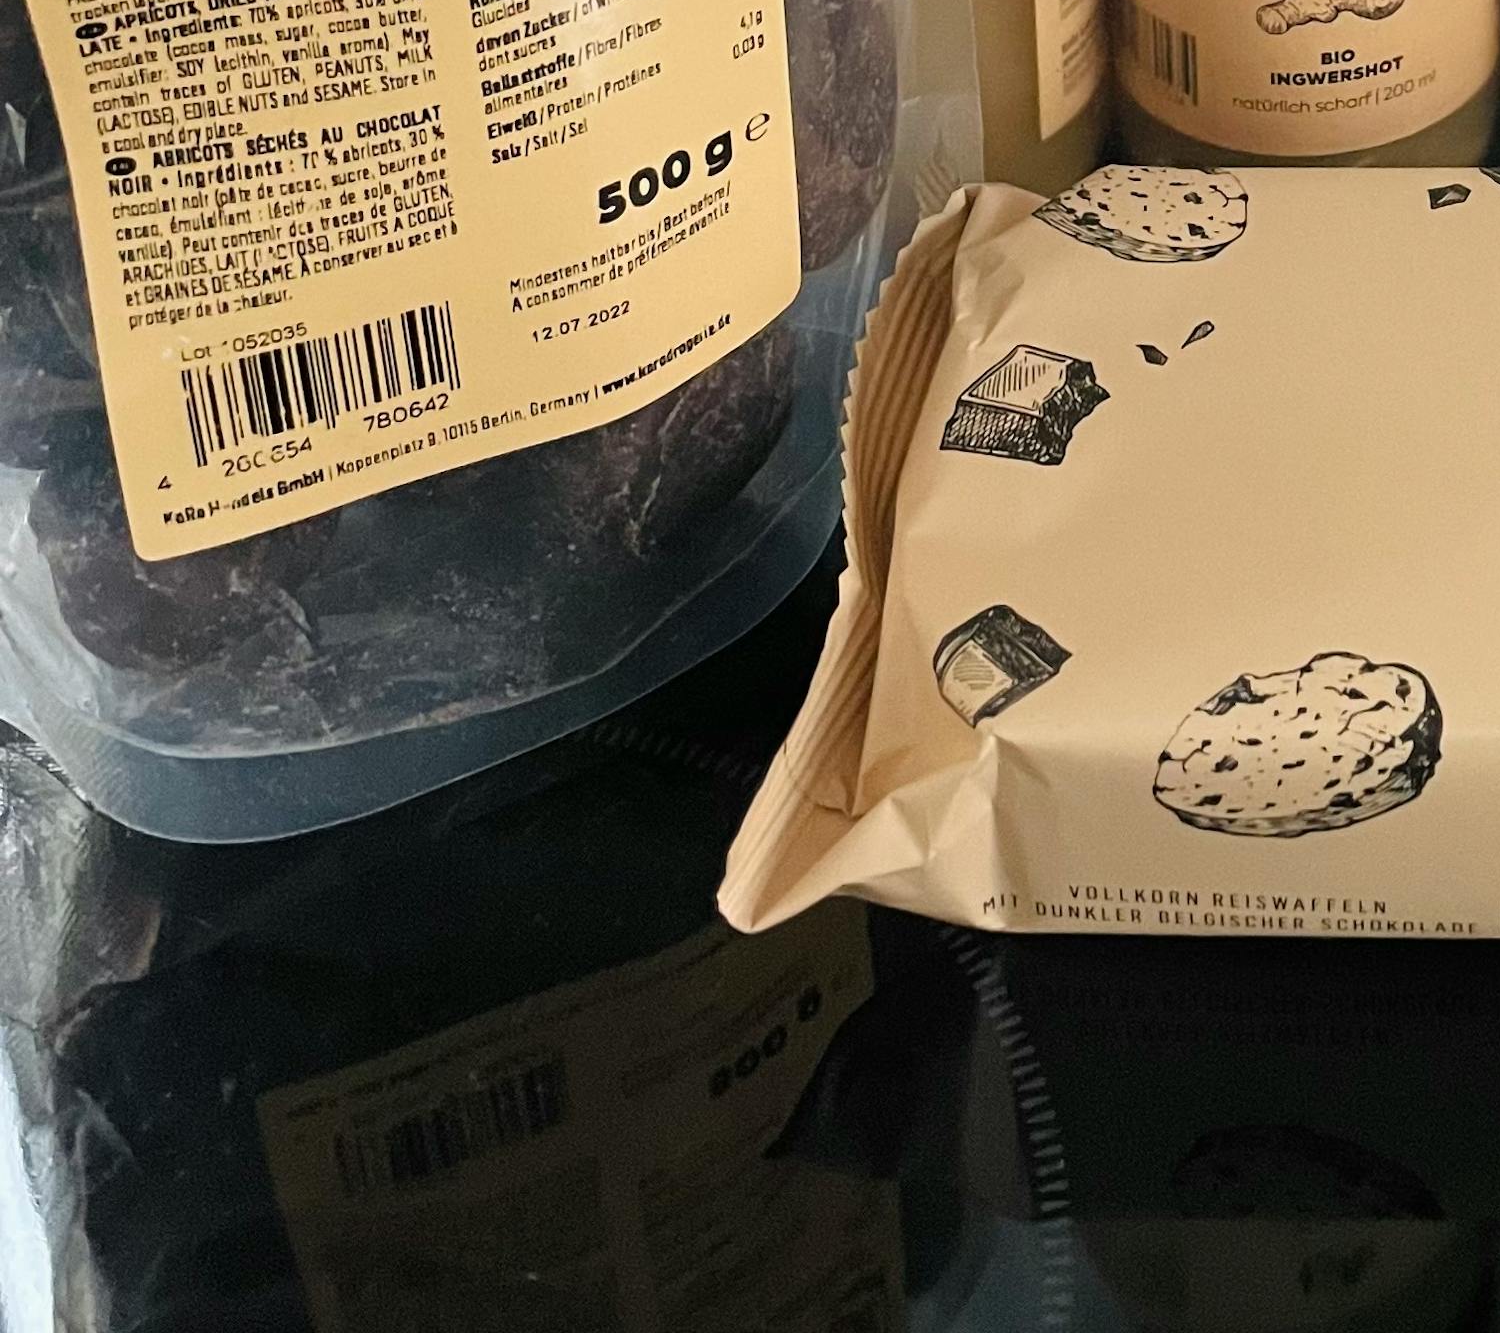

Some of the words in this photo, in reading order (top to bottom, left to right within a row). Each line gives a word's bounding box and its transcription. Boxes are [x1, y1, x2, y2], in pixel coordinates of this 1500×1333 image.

[79, 35, 123, 57] LATE
[397, 43, 433, 67] MILK
[1321, 49, 1355, 65] BIO
[1270, 56, 1404, 86] INGWERSHOT
[239, 93, 278, 113] NUTS
[380, 74, 419, 92] Store
[1232, 94, 1310, 115] natürlich
[1315, 91, 1371, 113] scharf
[1383, 79, 1415, 101] 200
[1418, 69, 1436, 87] ml
[153, 141, 234, 169] ABRICOTS
[246, 129, 308, 156] SÉCHÉS
[321, 127, 343, 145] AU
[357, 105, 441, 138] CHOCOLAT
[108, 175, 153, 197] NOIR
[599, 150, 693, 226] 500
[705, 130, 732, 176] g
[510, 262, 589, 295] Mindestens
[513, 297, 522, 313] A
[609, 261, 623, 281] de
[222, 322, 309, 356] 052035
[363, 393, 451, 434] 780642
[278, 469, 324, 495] GmbH
[444, 420, 477, 441] 10115
[531, 390, 589, 417] Germany
[984, 894, 1022, 916] MIT
[1035, 901, 1145, 923] DUNKLER
[1159, 909, 1304, 929] BELGISCHER
[1069, 885, 1198, 908] VOLLKORN
[1212, 893, 1385, 915] REISWAFFELN
